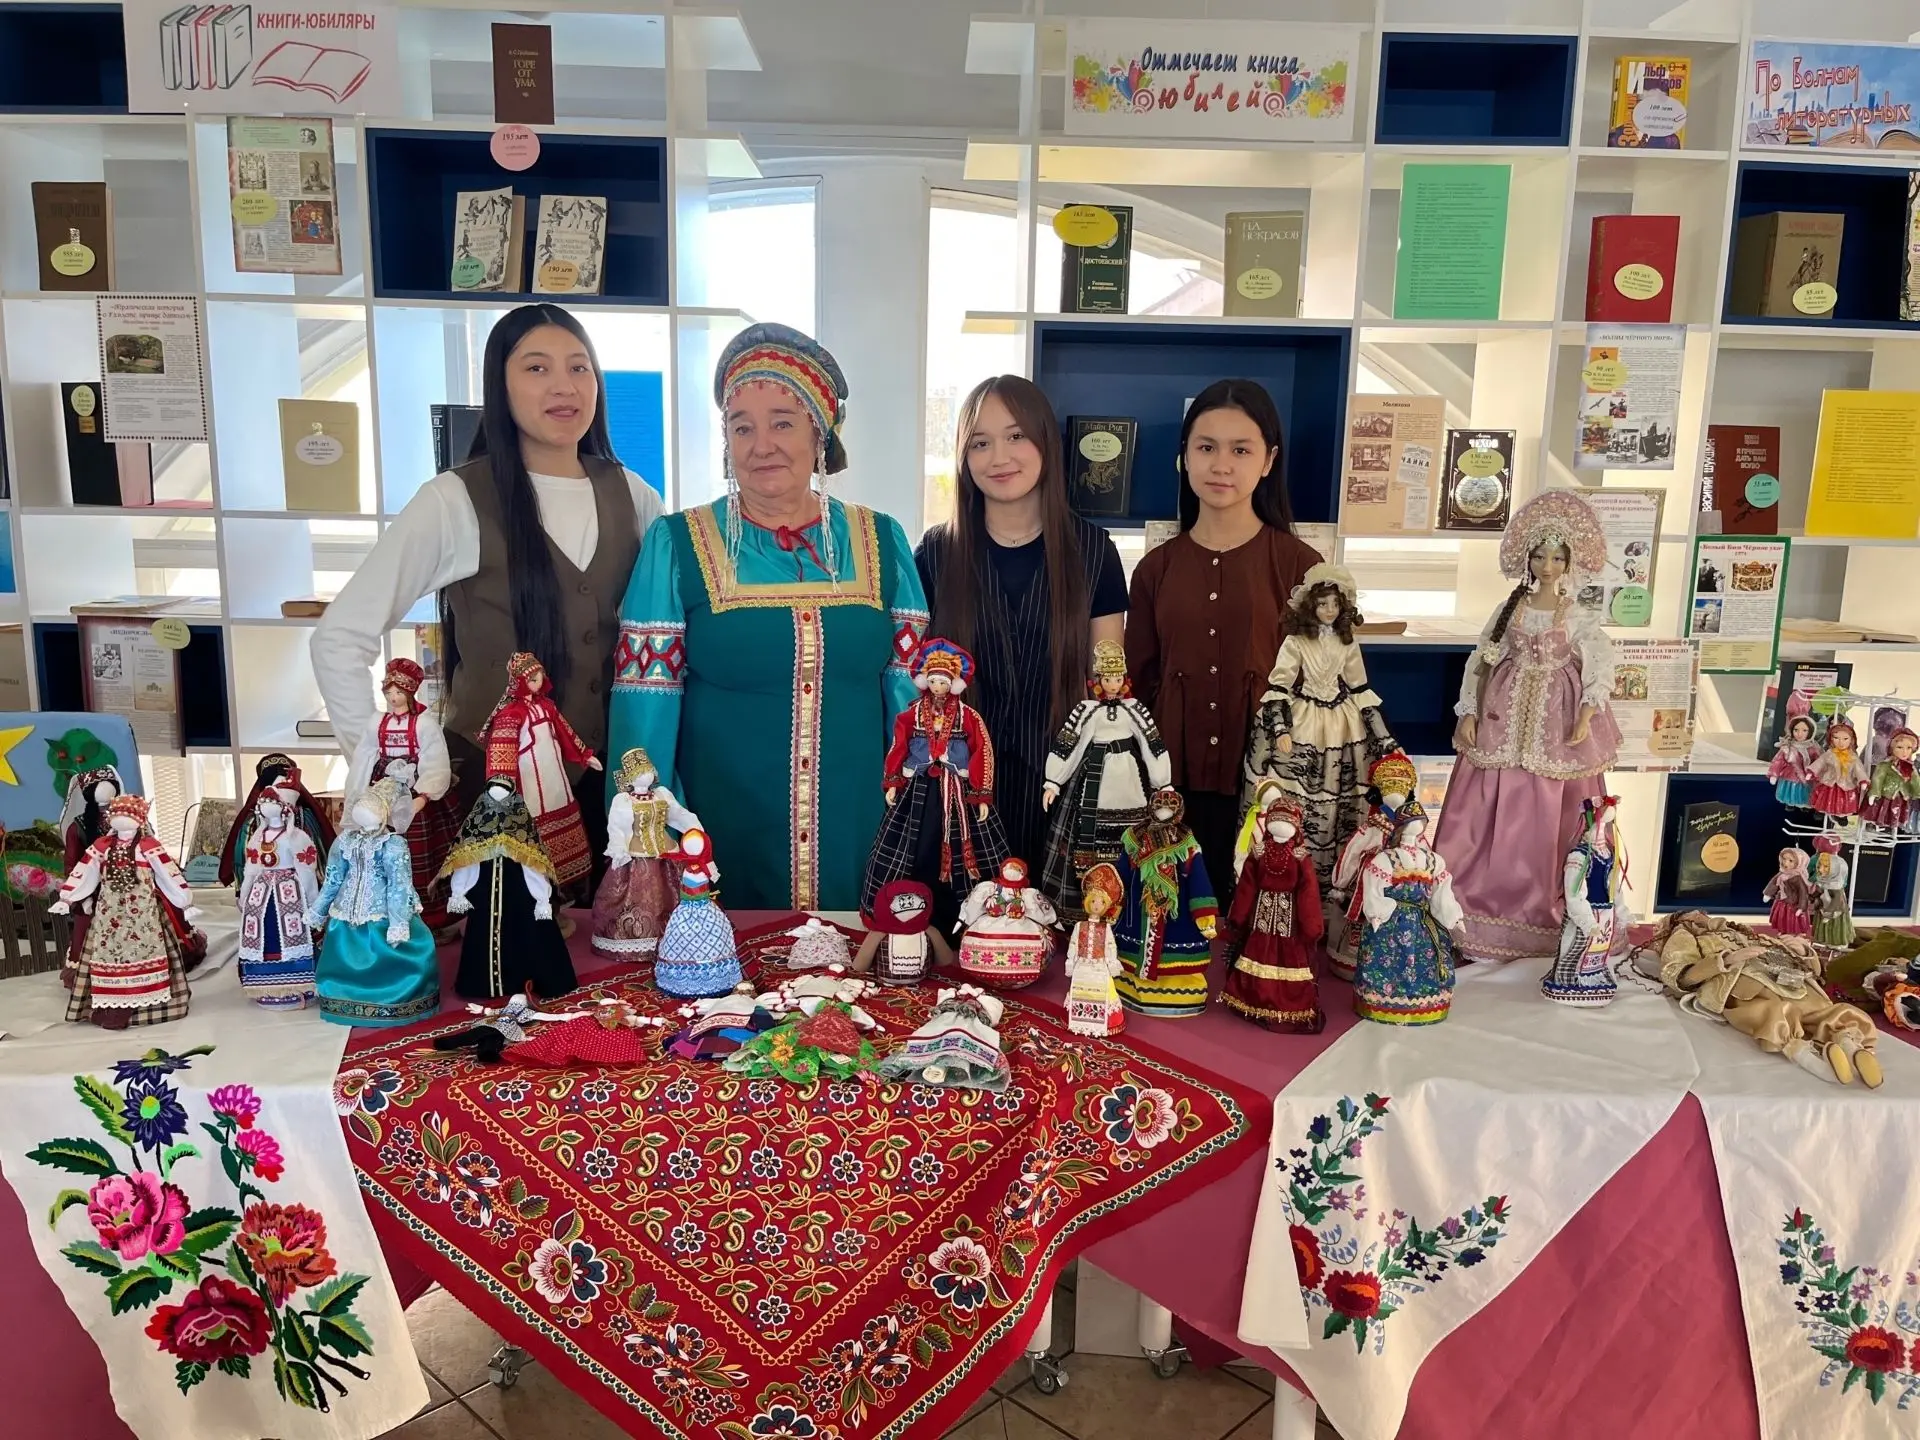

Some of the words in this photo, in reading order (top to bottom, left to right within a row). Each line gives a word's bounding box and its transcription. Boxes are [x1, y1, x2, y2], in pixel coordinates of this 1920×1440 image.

[257, 13, 375, 30] КНИГИ-ЮБИЛЯРЫ
[513, 60, 537, 69] ГОРЕ
[1141, 46, 1238, 73] Отмечает
[1247, 53, 1300, 74] книга
[517, 69, 532, 78] ОТ
[514, 78, 537, 88] УМА
[1756, 59, 1782, 111] По
[1158, 73, 1264, 112] юбилей
[1774, 90, 1911, 147] литературных
[1468, 438, 1499, 449] ЧЕХОВ
[1401, 455, 1430, 468] ЧАЙКА
